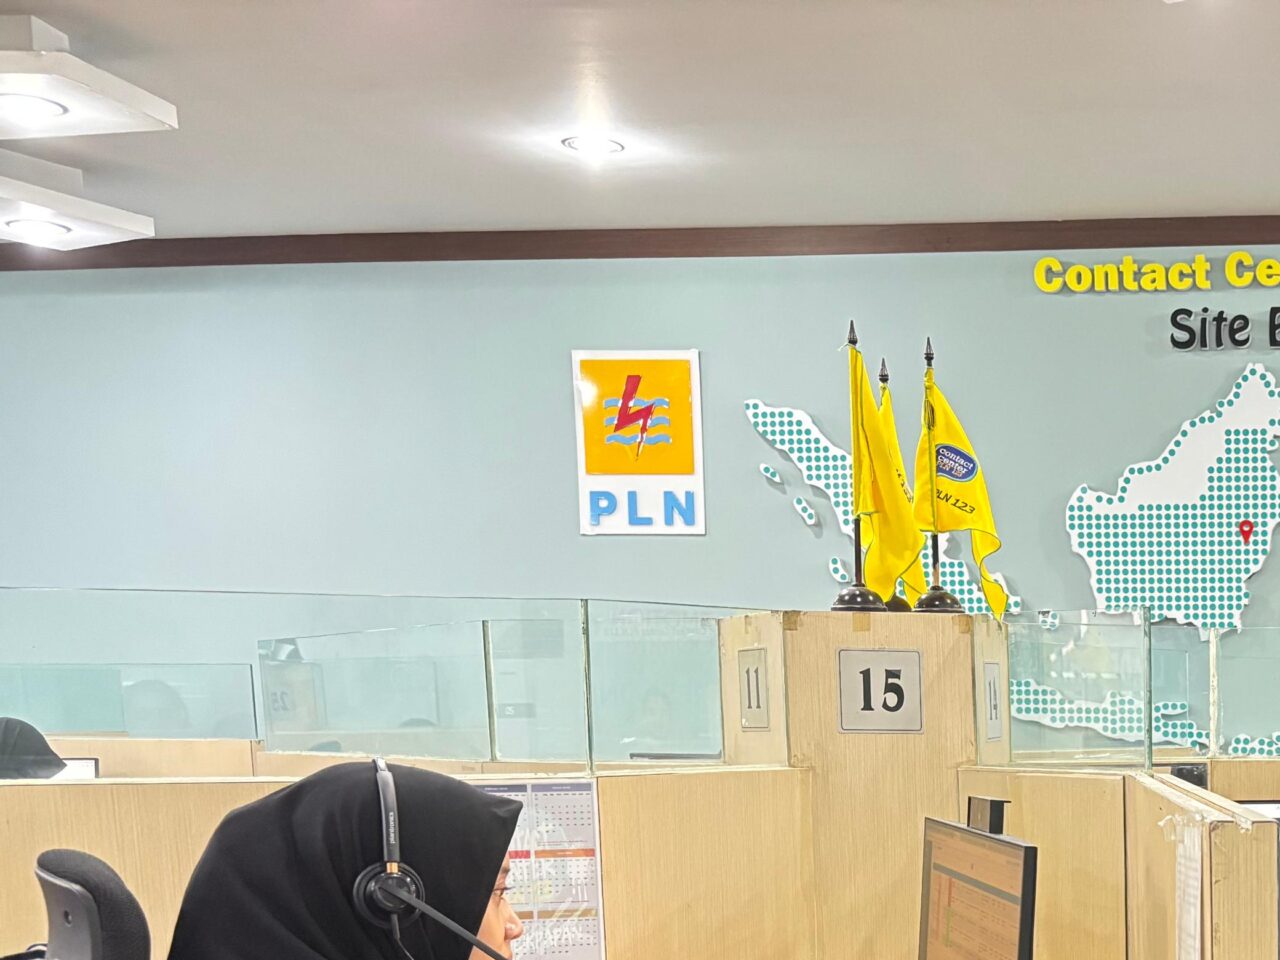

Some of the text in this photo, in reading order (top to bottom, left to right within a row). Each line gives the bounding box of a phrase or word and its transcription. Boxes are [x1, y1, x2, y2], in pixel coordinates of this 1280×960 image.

[1034, 254, 1211, 293] Contact
[1169, 306, 1251, 351] Site
[938, 455, 969, 474] center
[939, 448, 974, 470] contact
[589, 491, 695, 526] PLN
[951, 498, 976, 514] 123
[745, 666, 762, 709] 11
[859, 668, 905, 712] 15
